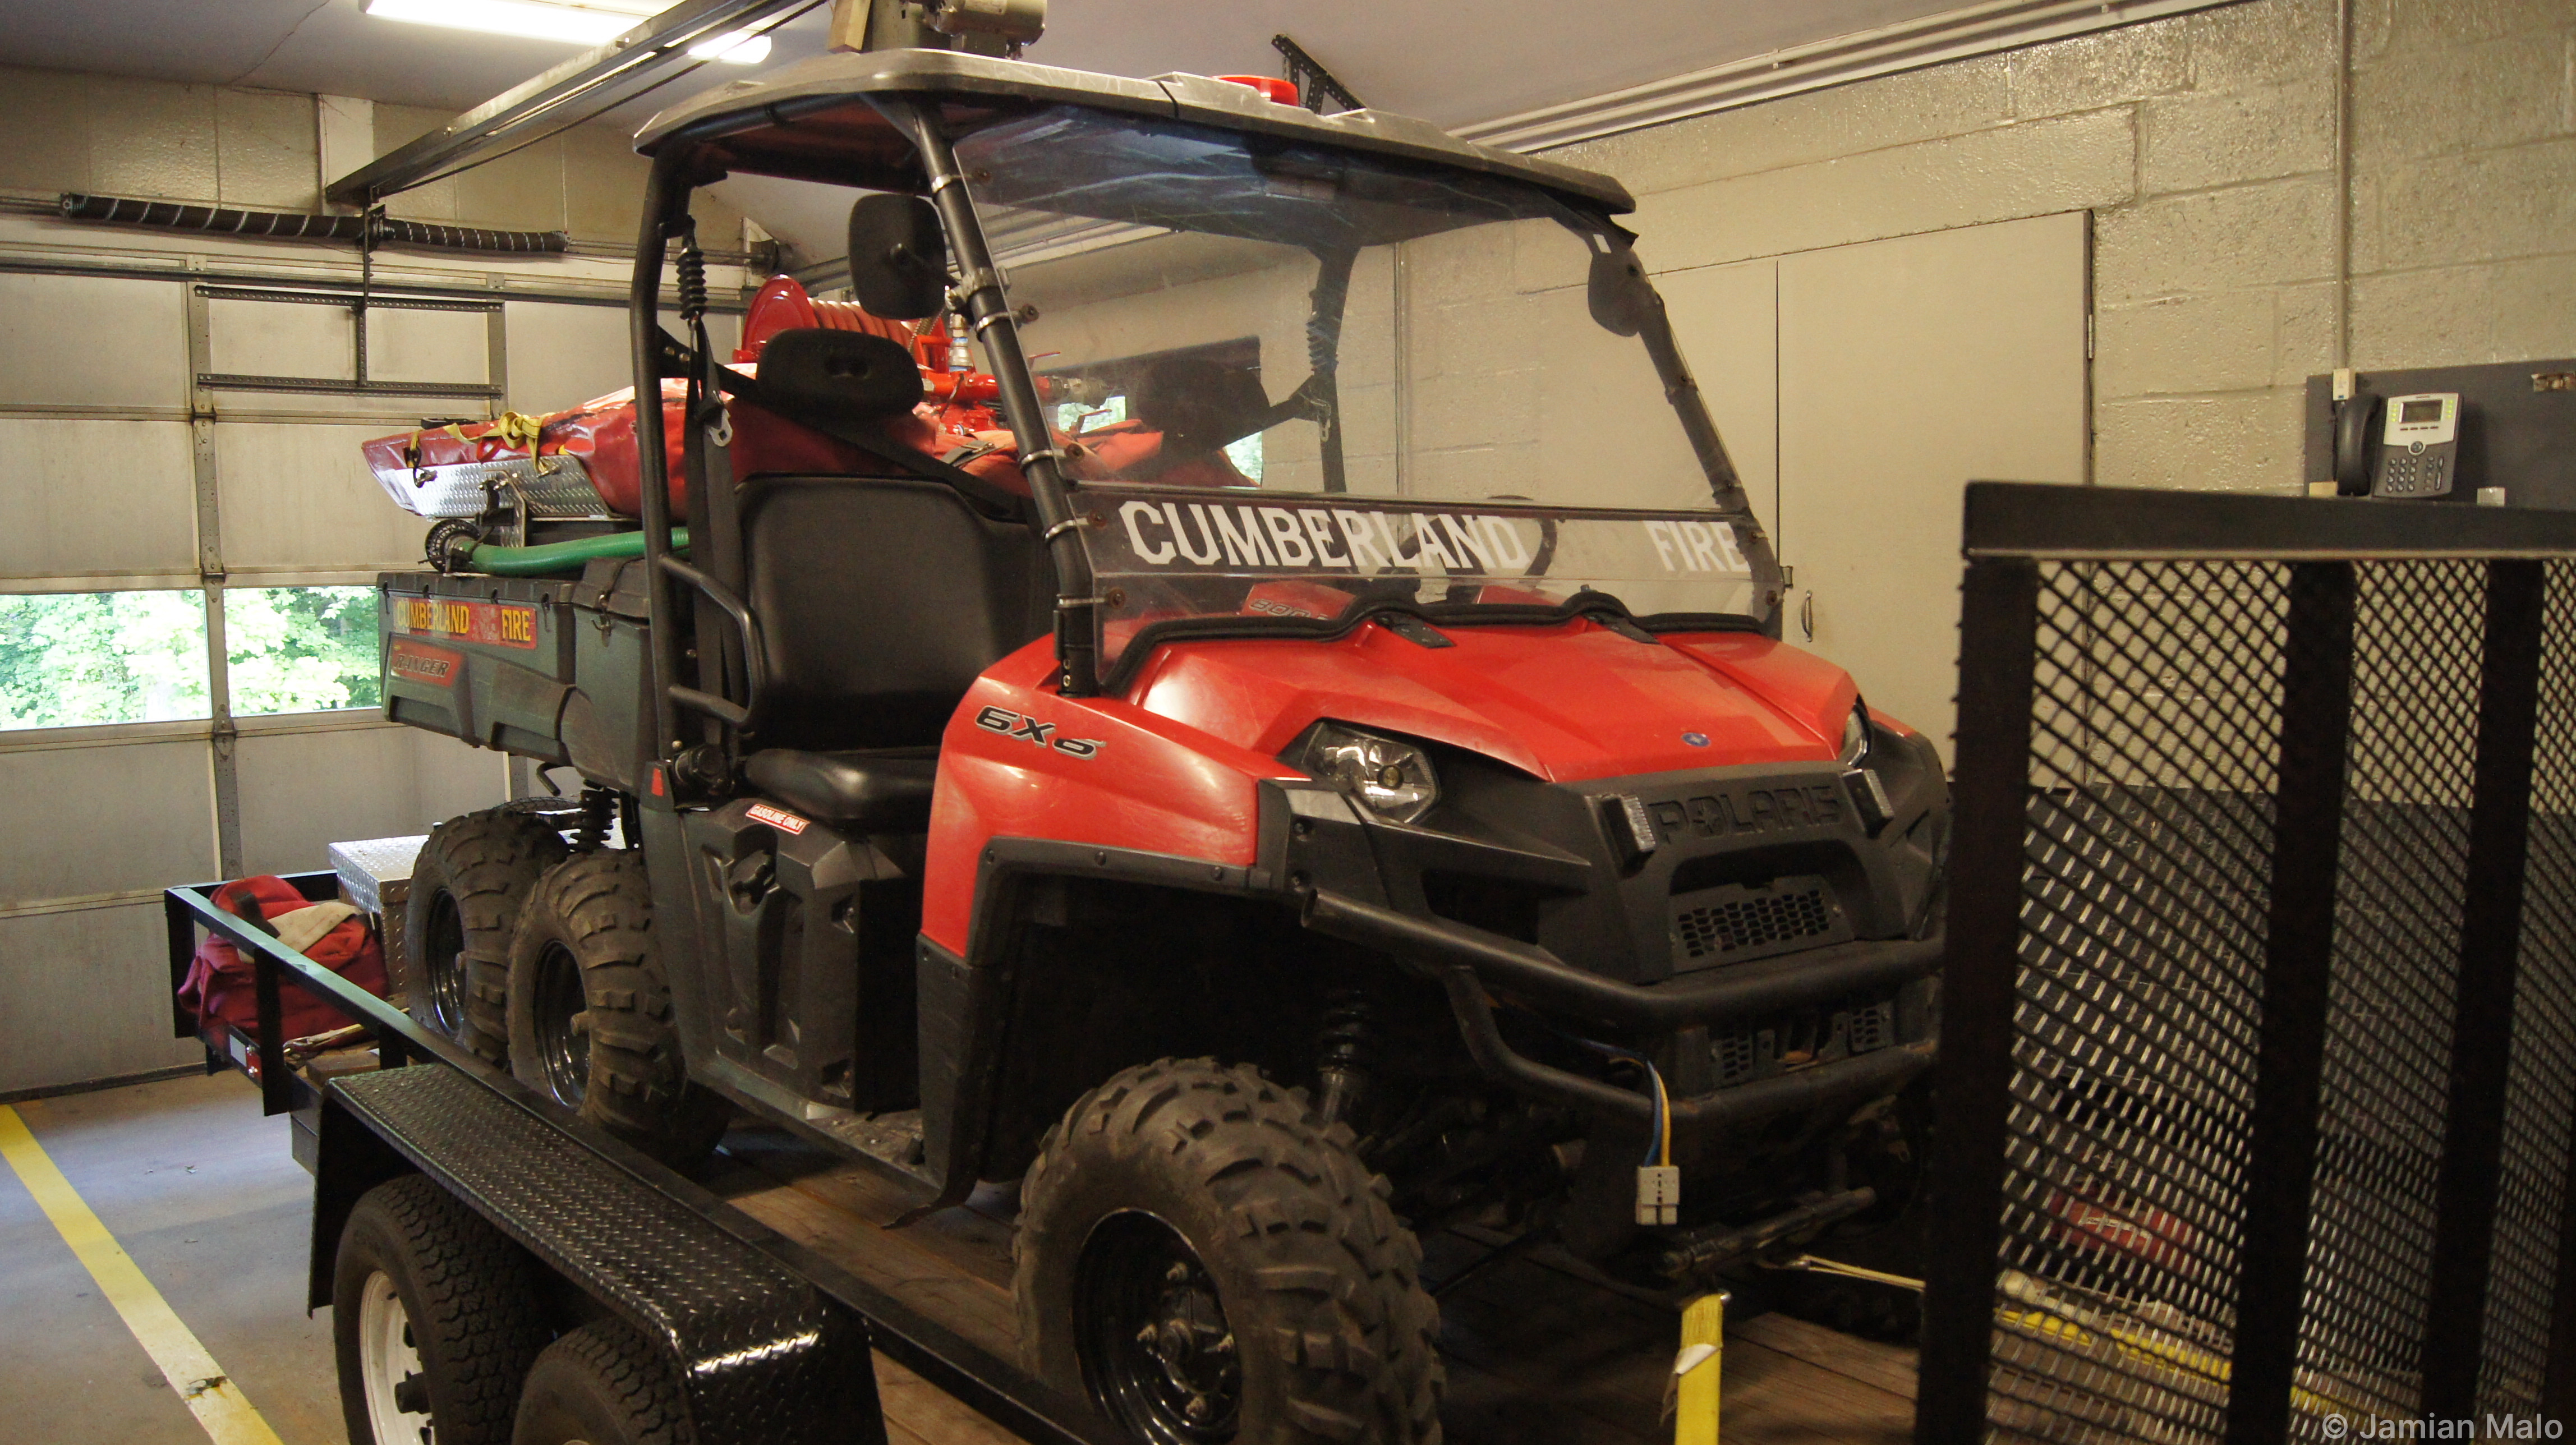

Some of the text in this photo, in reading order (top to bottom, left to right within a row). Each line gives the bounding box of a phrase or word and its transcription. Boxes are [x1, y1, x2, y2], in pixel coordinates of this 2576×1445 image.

[1118, 500, 1751, 572] CUMBERLAND FIRE
[397, 600, 531, 641] CUMBERLAND FIRE
[750, 806, 806, 830] GASOLINE ONLY
[1648, 785, 1843, 845] POLARIS
